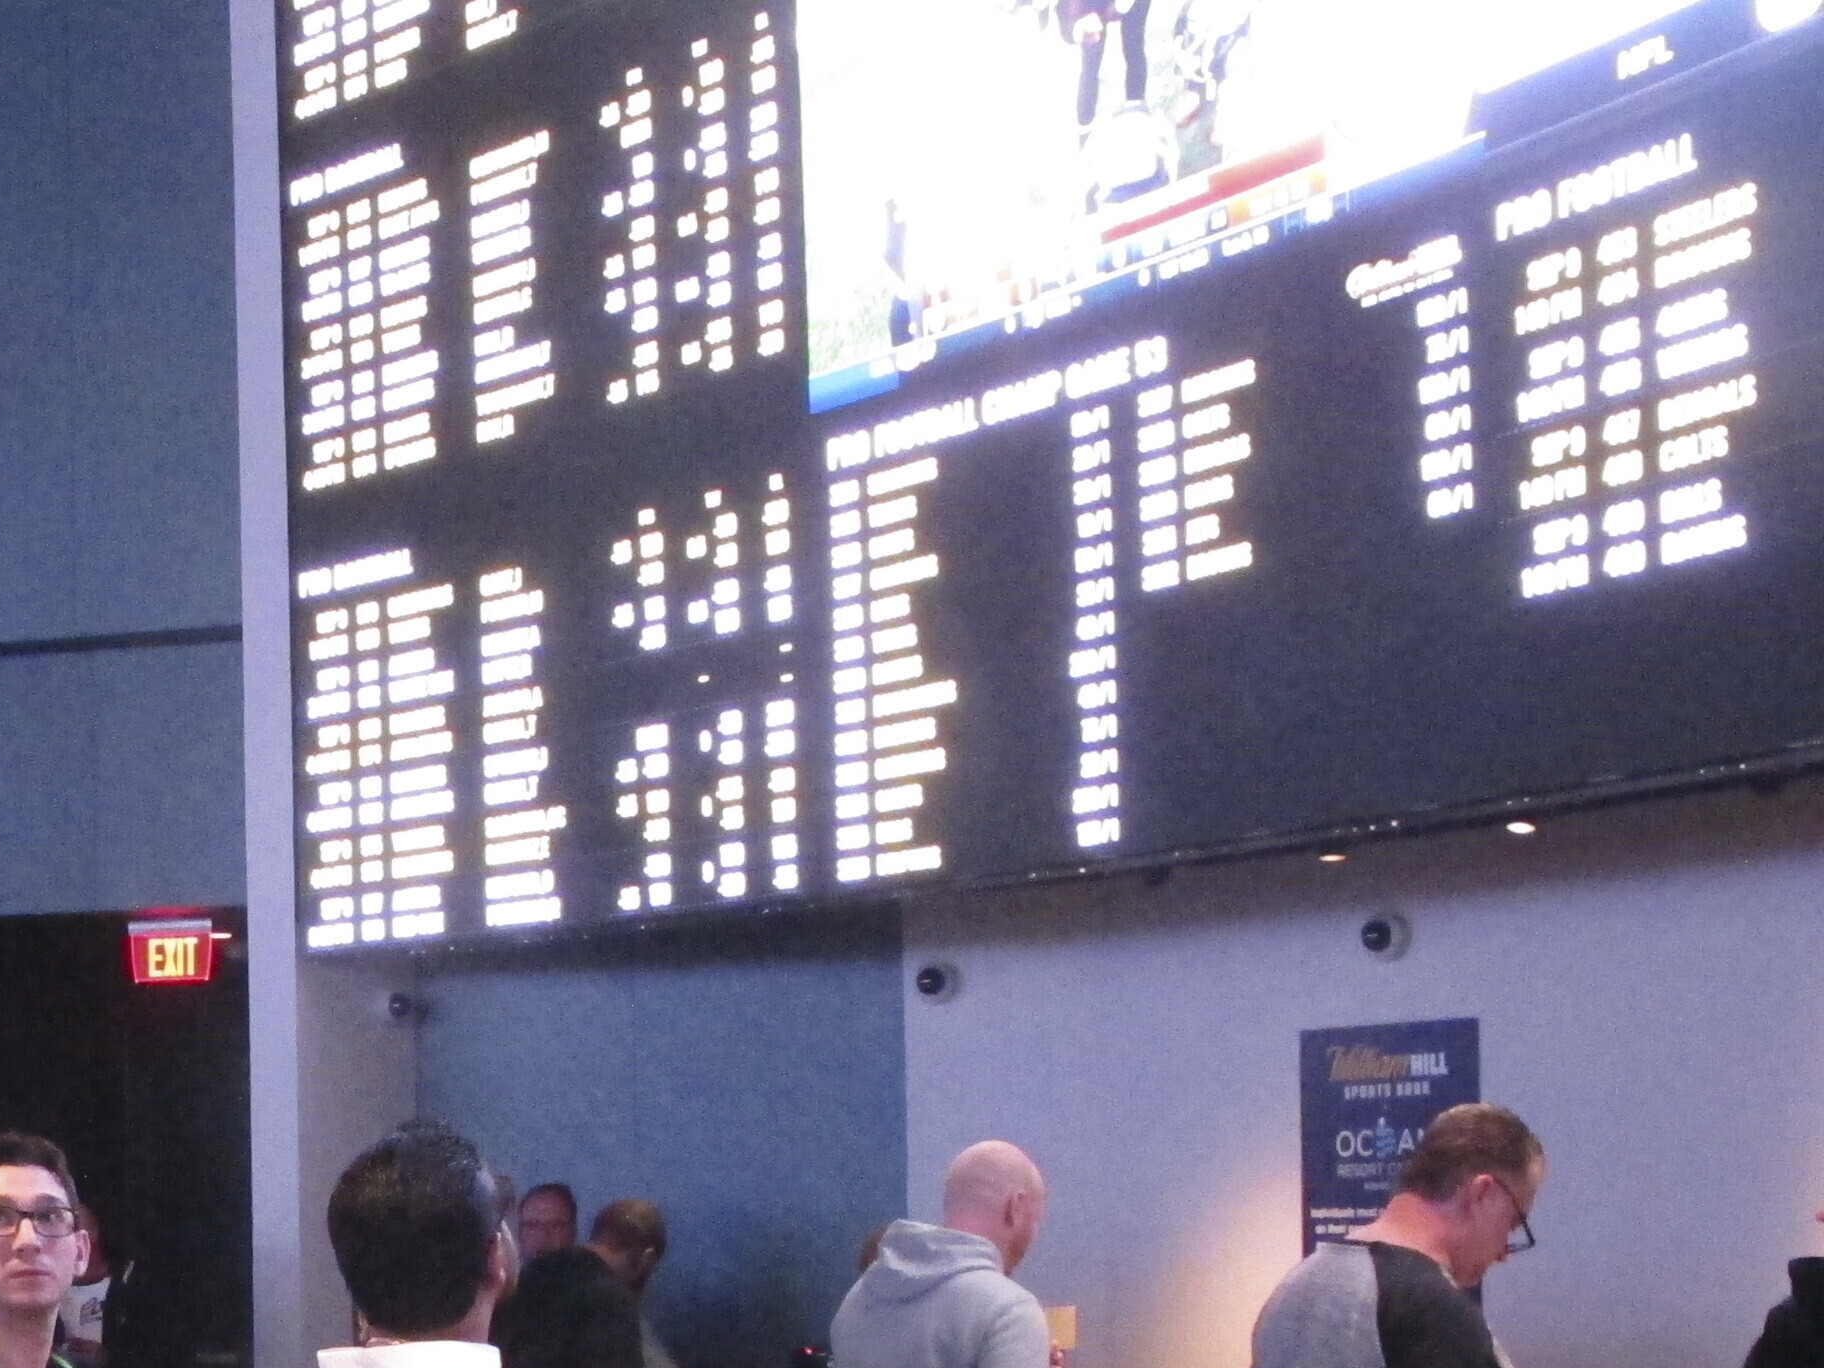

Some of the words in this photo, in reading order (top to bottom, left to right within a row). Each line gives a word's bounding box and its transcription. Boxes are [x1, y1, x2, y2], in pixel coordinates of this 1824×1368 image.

[1496, 189, 1552, 241] PRO
[1557, 134, 1697, 218] FOOTBALL
[1654, 183, 1757, 246] STEELERS
[827, 430, 871, 471] PRO
[874, 398, 979, 457] FOOTBALL
[1065, 347, 1131, 399] GAME
[1660, 426, 1728, 471] COLTS
[149, 937, 198, 977] EXIT
[1410, 1051, 1449, 1077] HILL
